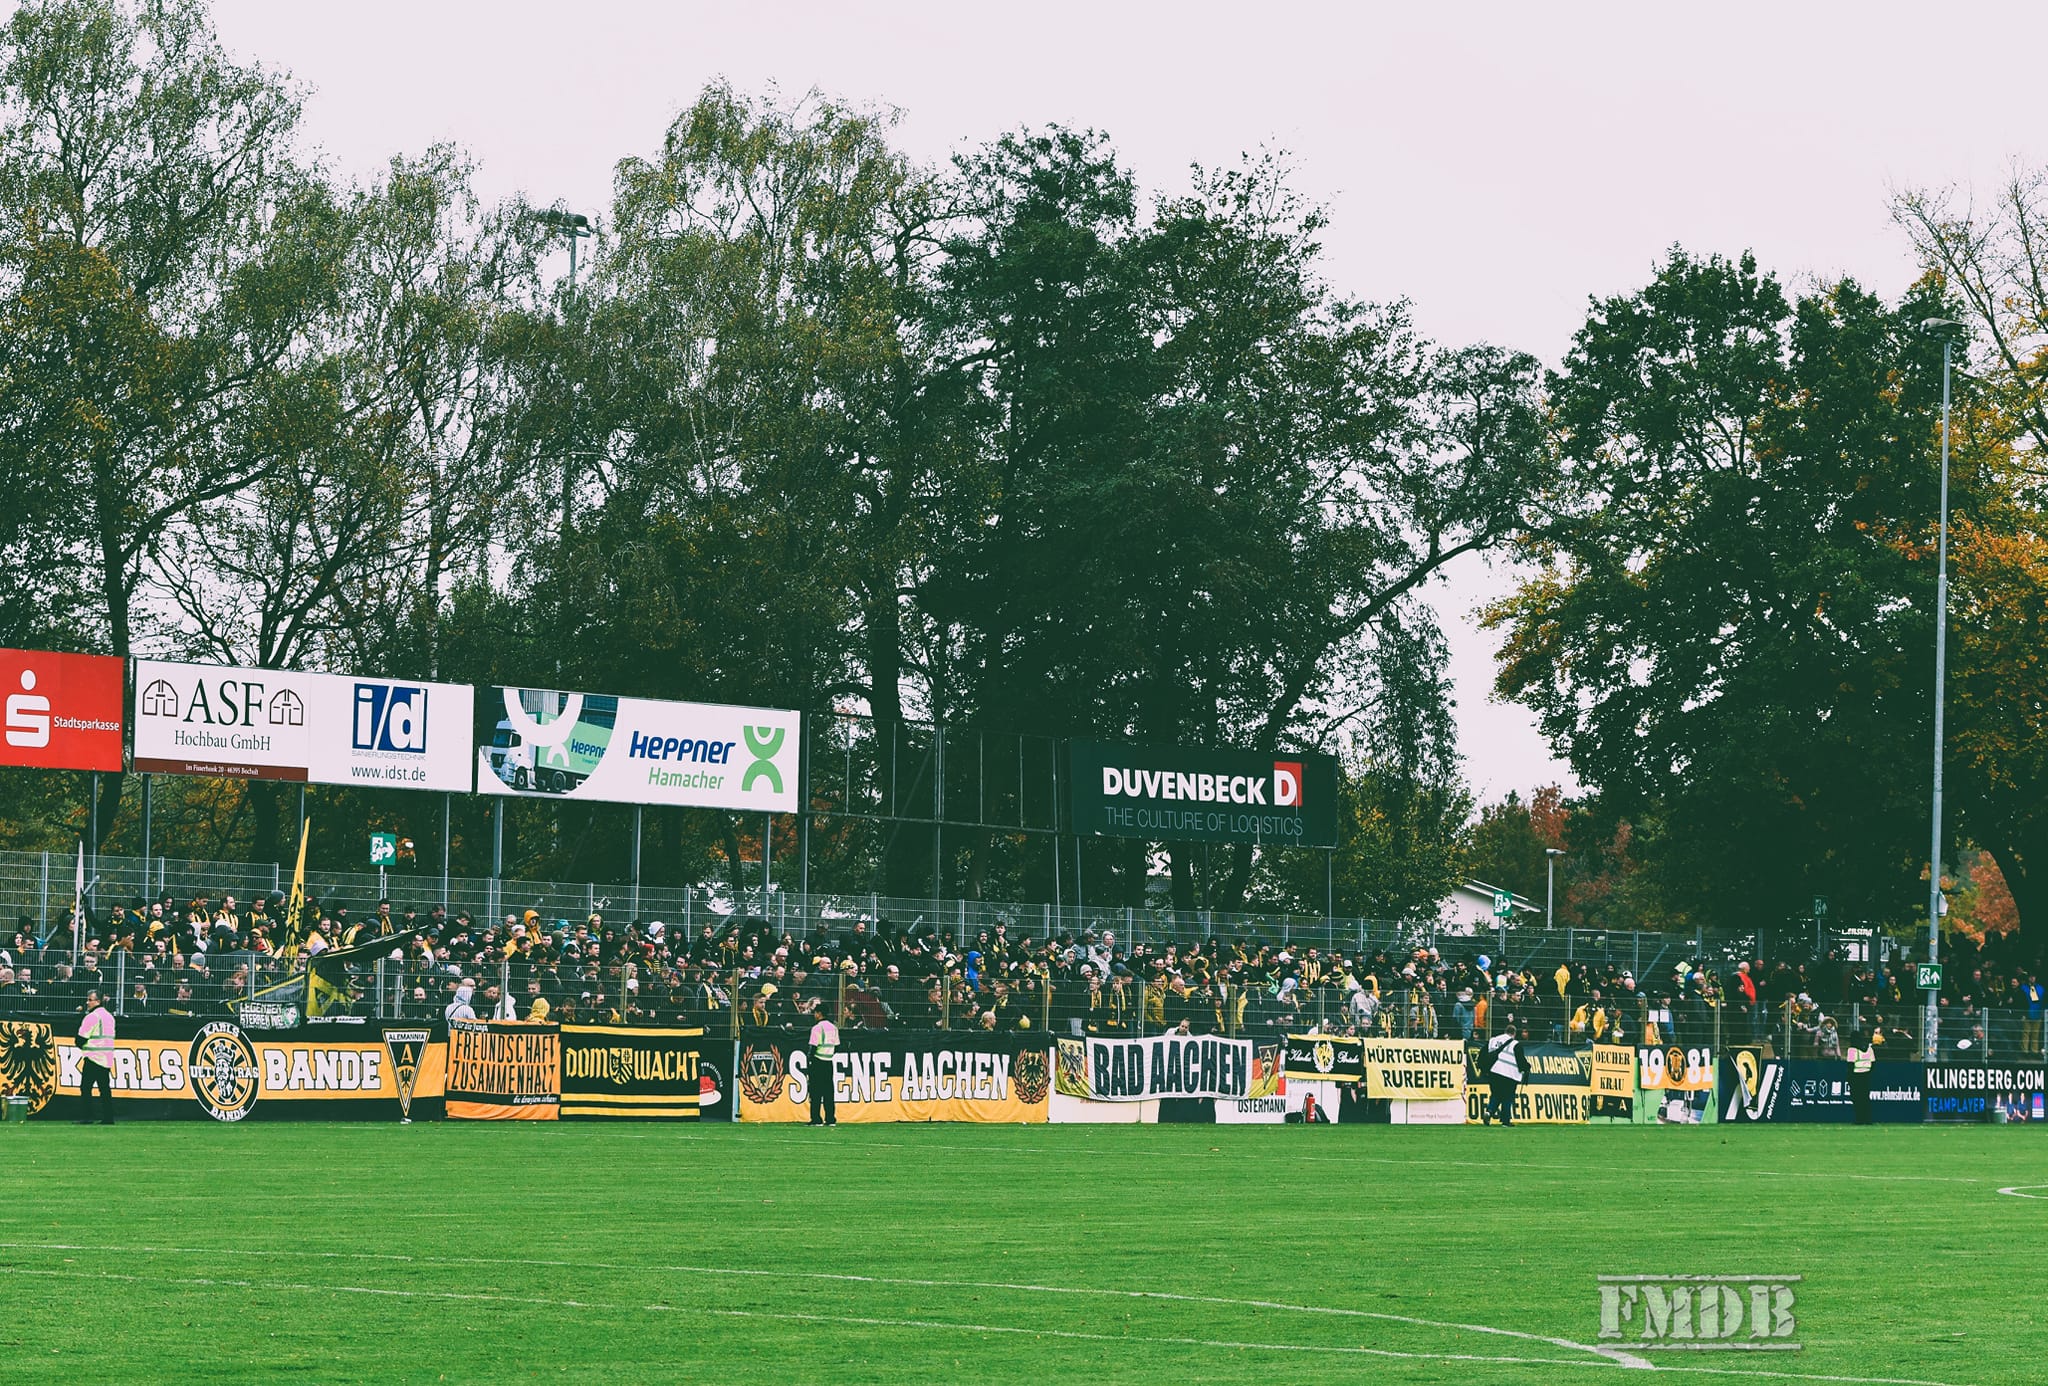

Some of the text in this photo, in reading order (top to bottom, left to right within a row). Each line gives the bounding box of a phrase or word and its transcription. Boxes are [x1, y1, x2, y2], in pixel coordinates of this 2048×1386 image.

[182, 678, 265, 727] ASF
[54, 716, 120, 732] Stadtsparkasse
[174, 729, 271, 752] Hochbau GmbH
[351, 765, 426, 782] www.idst.de
[648, 767, 725, 790] Hamacher
[1103, 767, 1267, 806] DUVENBECK
[1104, 806, 1304, 837] THE CULTURE OF LOGISTICS
[240, 1002, 283, 1015] LEGENDEN
[203, 1022, 240, 1038] KARLS
[388, 1033, 425, 1041] ALEMANNIA
[455, 1032, 555, 1063] FREUNDSCHAFT
[1368, 1046, 1463, 1065] HÜRTGENWALD
[1595, 1051, 1631, 1065] OECHER
[57, 1045, 185, 1090] KRLS
[263, 1048, 382, 1091] BANDE
[565, 1047, 609, 1078] DOM
[633, 1050, 700, 1081] WACHT
[1093, 1040, 1247, 1097] BAD AACHEN
[1543, 1055, 1580, 1075] AACHEN
[1639, 1048, 1713, 1087] 19 81
[451, 1060, 555, 1094] ZUSAMMENHALT
[789, 1050, 1010, 1103] SENE AACHEN
[1383, 1070, 1454, 1089] RUREIFEL
[1600, 1076, 1625, 1091] KRAU
[1926, 1068, 2045, 1091] KLINGEBERG.COM
[1468, 1087, 1530, 1120] ÖEER
[1535, 1093, 1578, 1120] POWER
[1767, 1065, 1785, 1120] rehms druck
[1869, 1086, 1921, 1102] www.rehmsdruck.de
[210, 1104, 247, 1121] BANDE
[1238, 1098, 1286, 1113] OSTERMANN
[1927, 1096, 1985, 1113] TEAMPLAYER
